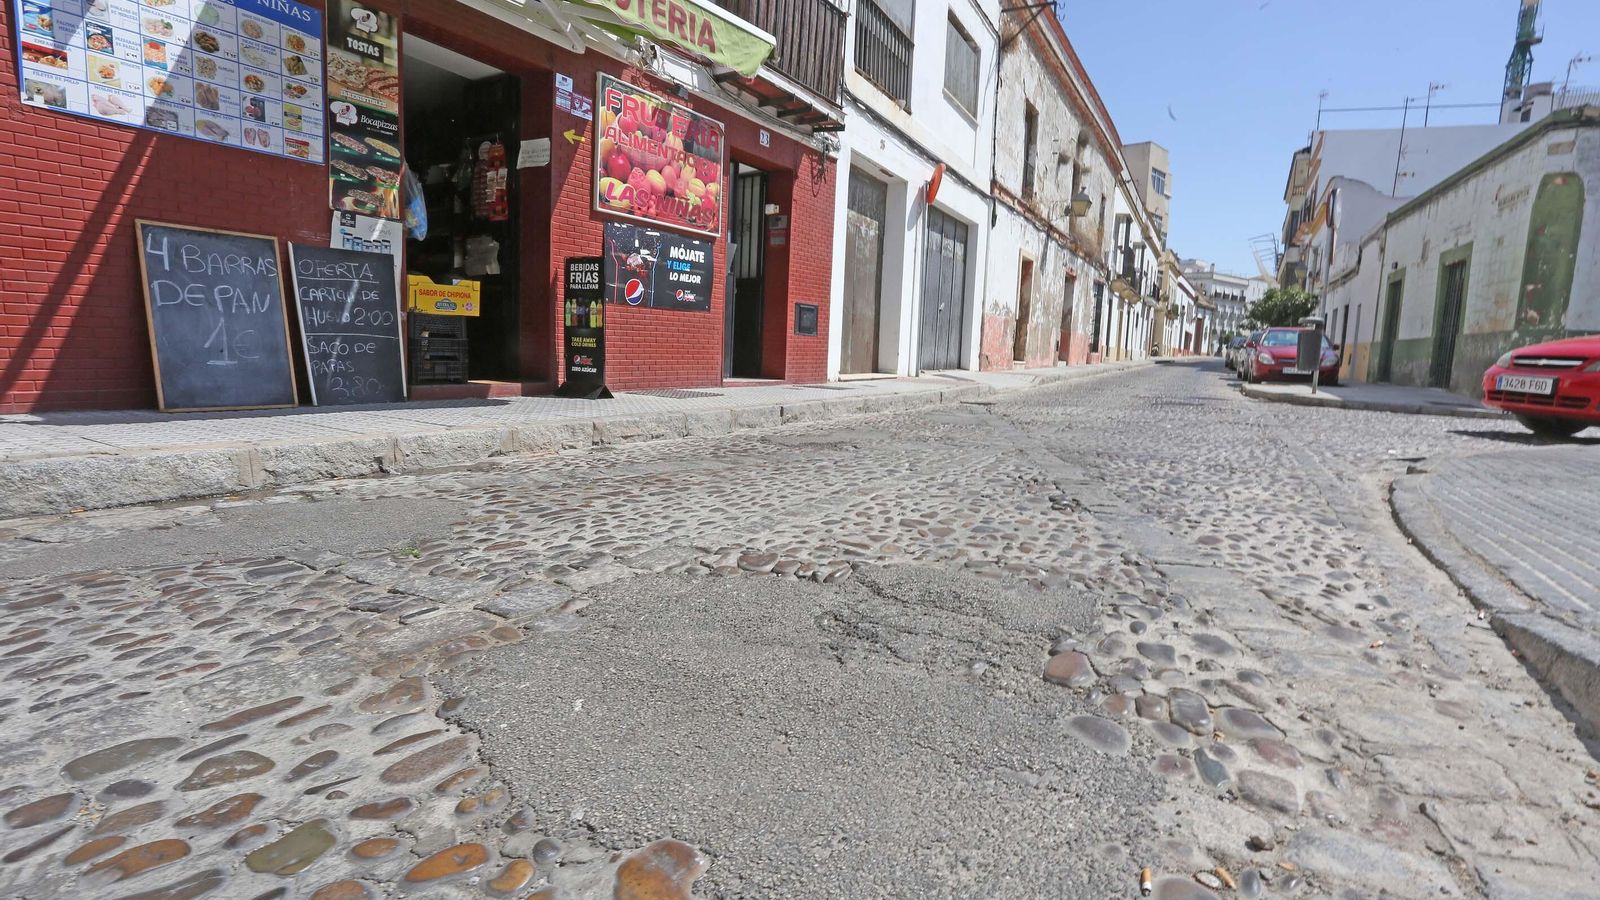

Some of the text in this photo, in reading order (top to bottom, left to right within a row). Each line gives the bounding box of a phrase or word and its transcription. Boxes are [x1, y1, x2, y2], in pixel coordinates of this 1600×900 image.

[346, 36, 380, 57] TOSTAS
[360, 115, 398, 131] Bocapizzas
[605, 181, 650, 208] LAS
[146, 232, 278, 277] 4 BARRAS
[669, 244, 705, 263] MÓJATE
[298, 259, 374, 281] OFERTA
[570, 263, 599, 272] BEBIDAS
[667, 260, 691, 272] Y ELIGE
[570, 271, 599, 284] FRÍAS
[669, 271, 701, 285] LO MEJOR
[150, 279, 271, 314] DE PAN
[361, 290, 380, 300] DE
[418, 288, 471, 299] SABOR DE CHIPIONA
[307, 336, 377, 356] SACO DE
